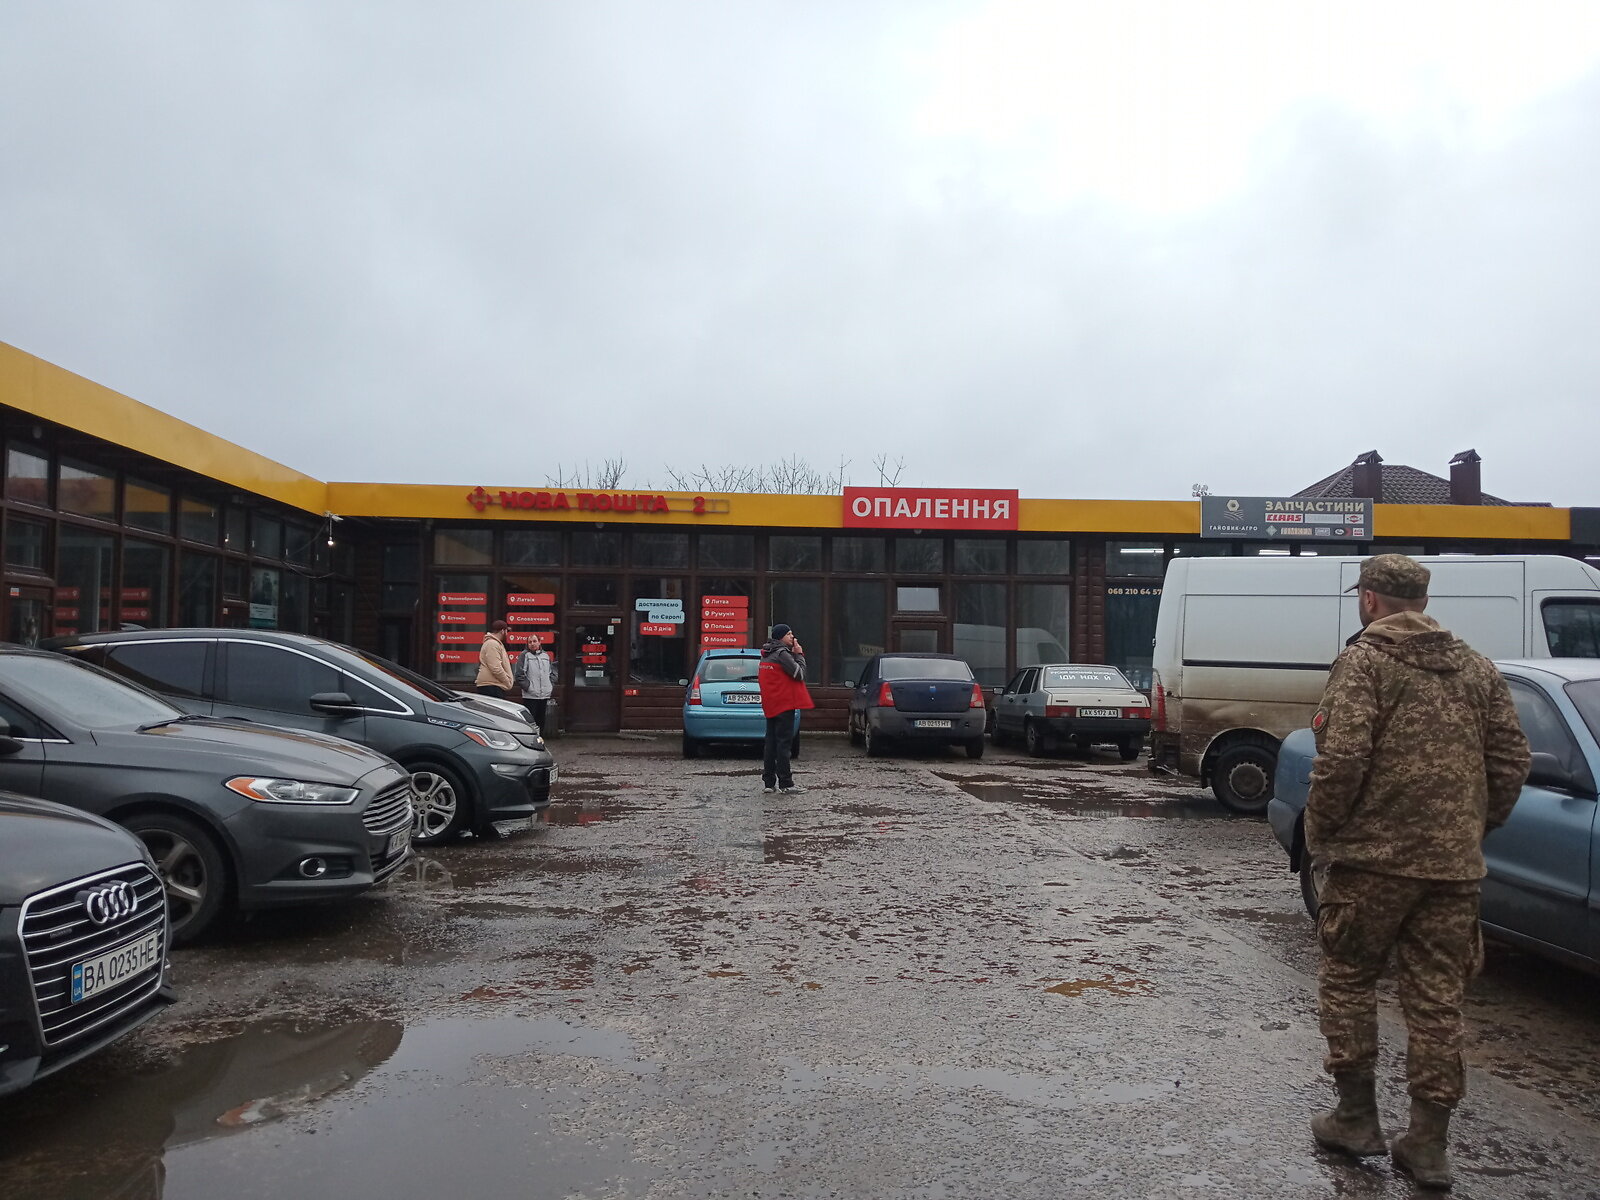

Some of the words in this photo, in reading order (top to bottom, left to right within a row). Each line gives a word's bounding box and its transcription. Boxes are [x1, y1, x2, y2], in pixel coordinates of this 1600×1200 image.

[500, 491, 570, 511] НОВА
[577, 493, 670, 513] ПОШТА
[692, 496, 705, 515] 2
[852, 497, 1010, 519] ОПАЛЕННЯ
[1265, 501, 1365, 512] ЗАПЧАСТИНИ
[1266, 514, 1303, 522] CLAAS
[727, 694, 736, 702] AB
[84, 961, 106, 993] BA
[109, 946, 138, 982] 0235
[141, 937, 154, 967] HE
